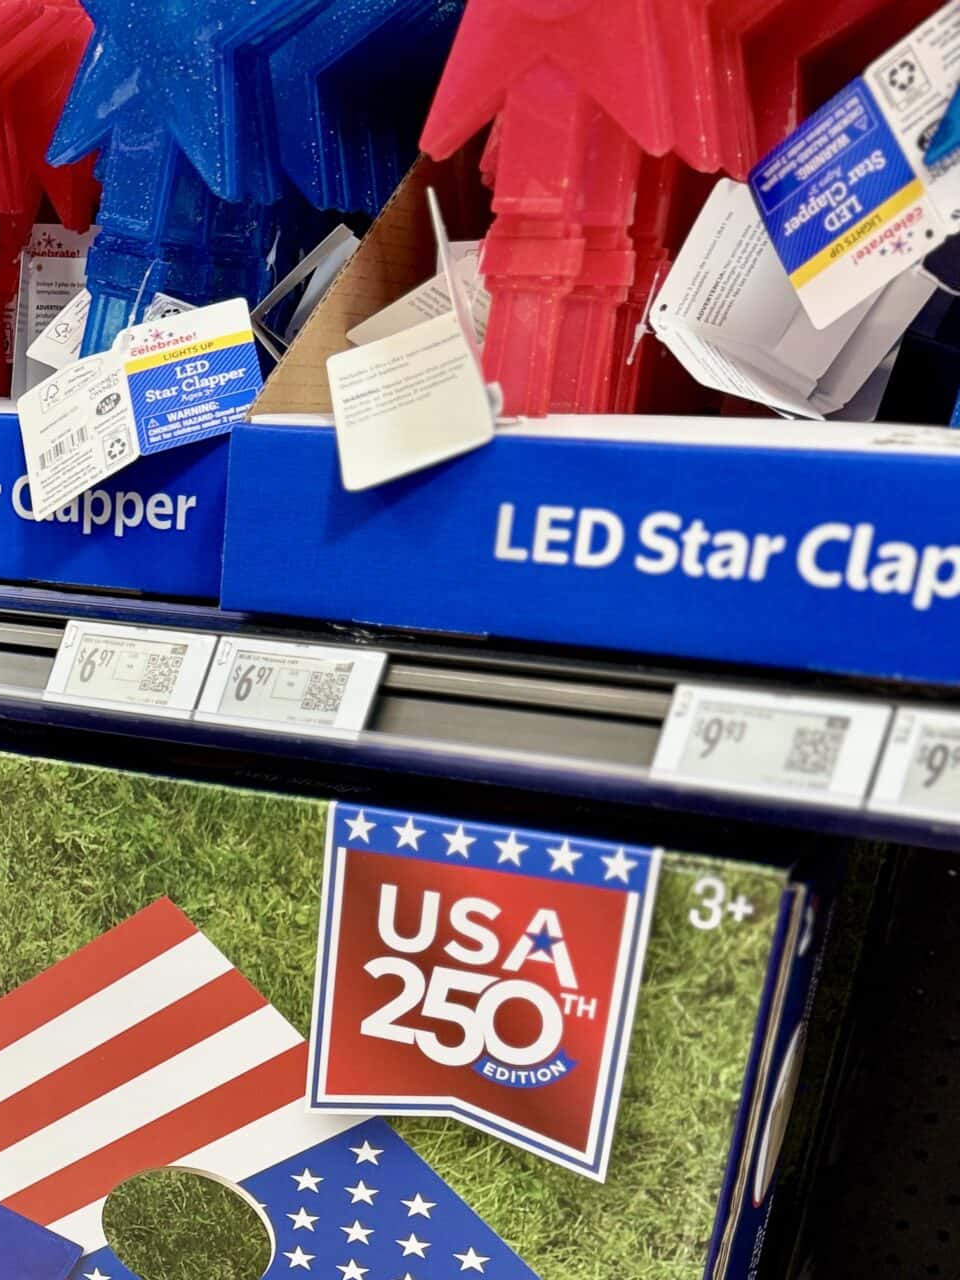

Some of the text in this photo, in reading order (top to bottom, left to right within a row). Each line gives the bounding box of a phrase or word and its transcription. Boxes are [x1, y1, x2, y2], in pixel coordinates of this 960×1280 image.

[784, 150, 886, 237] Star Clapper
[824, 195, 862, 232] LED
[830, 214, 883, 258] LIGHTS UP
[851, 207, 923, 265] celebrate!
[130, 332, 197, 356] celebrate!
[163, 342, 214, 360] LIGHTS UP
[145, 368, 246, 403] Star Clapper
[175, 360, 209, 379] LED
[167, 402, 220, 421] WARNING:
[11, 472, 196, 537] Capper
[494, 503, 960, 611] LED Star Clap
[688, 876, 754, 930] 3+
[377, 883, 579, 990] USA
[482, 1059, 568, 1087] EDITION
